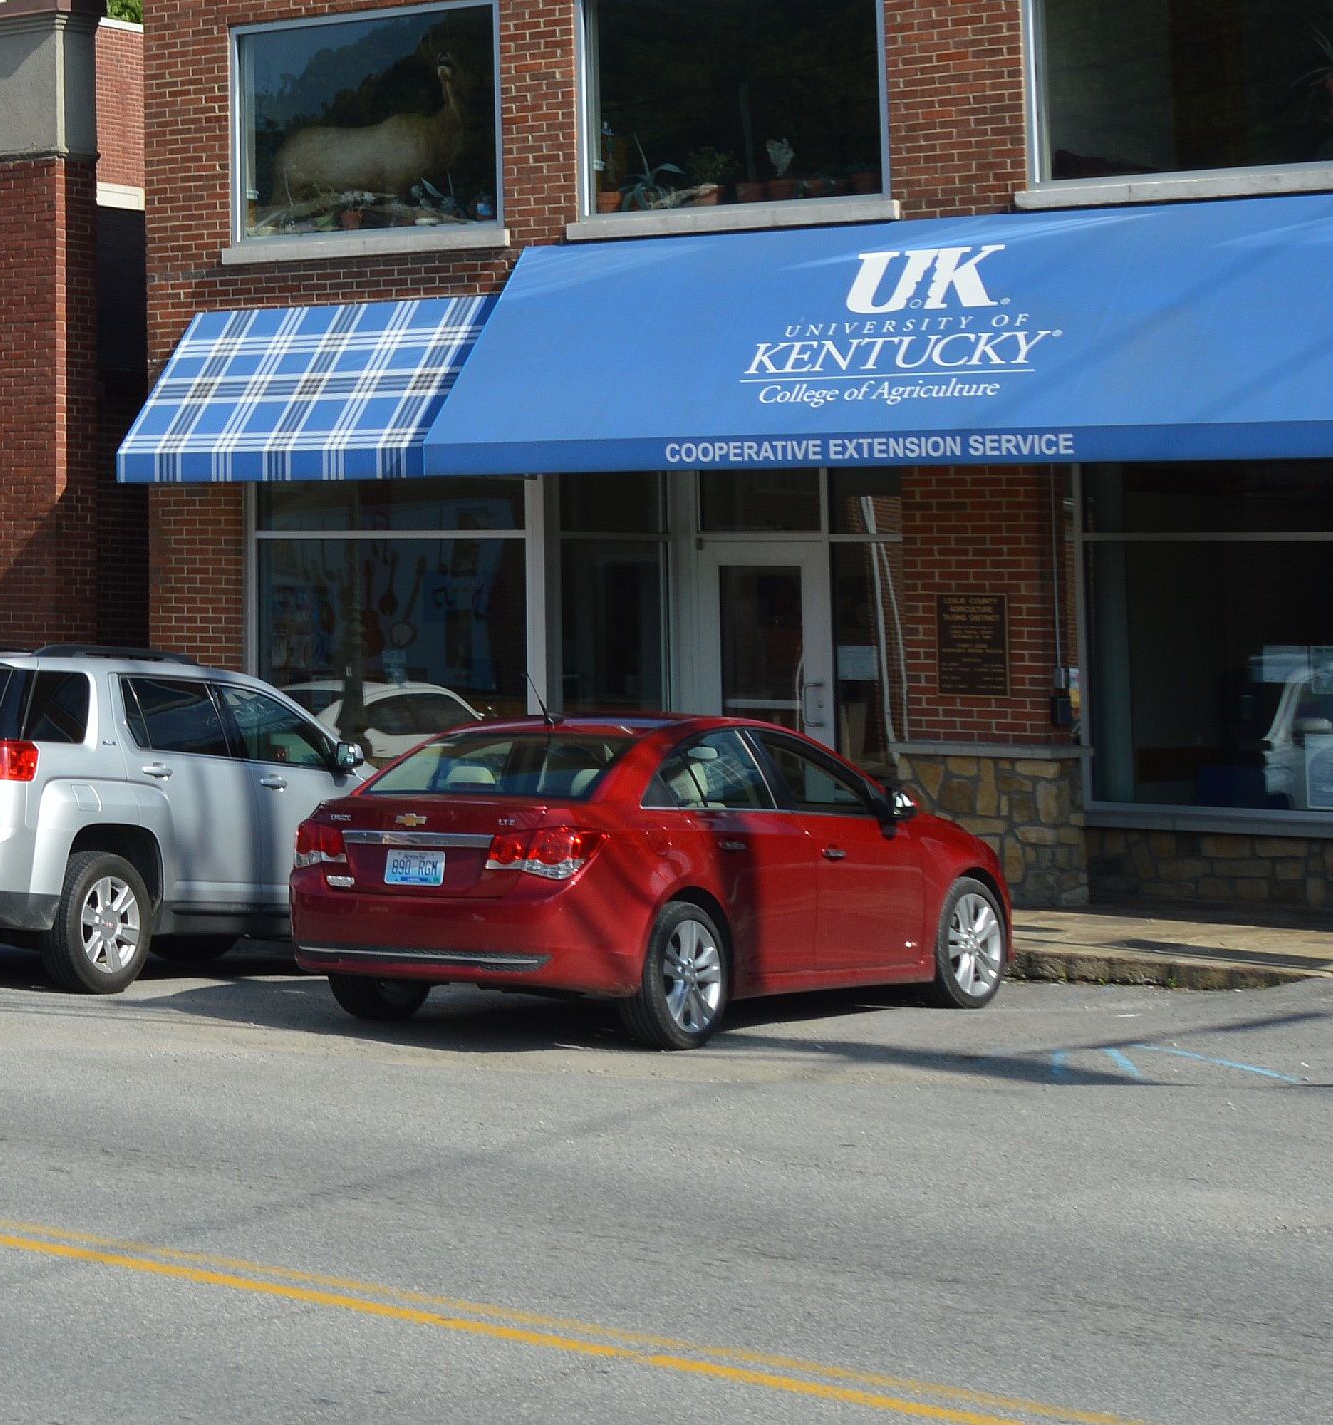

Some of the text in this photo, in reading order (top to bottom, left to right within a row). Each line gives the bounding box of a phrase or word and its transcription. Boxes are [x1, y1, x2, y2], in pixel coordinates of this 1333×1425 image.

[846, 243, 1006, 314] UK
[785, 313, 1030, 338] UNIVERSITY OF
[744, 330, 1052, 374] KENTUCKY
[759, 378, 1000, 408] College of Agriculture
[666, 433, 1075, 463] COOPERATIVE EXTENSION SERVICE
